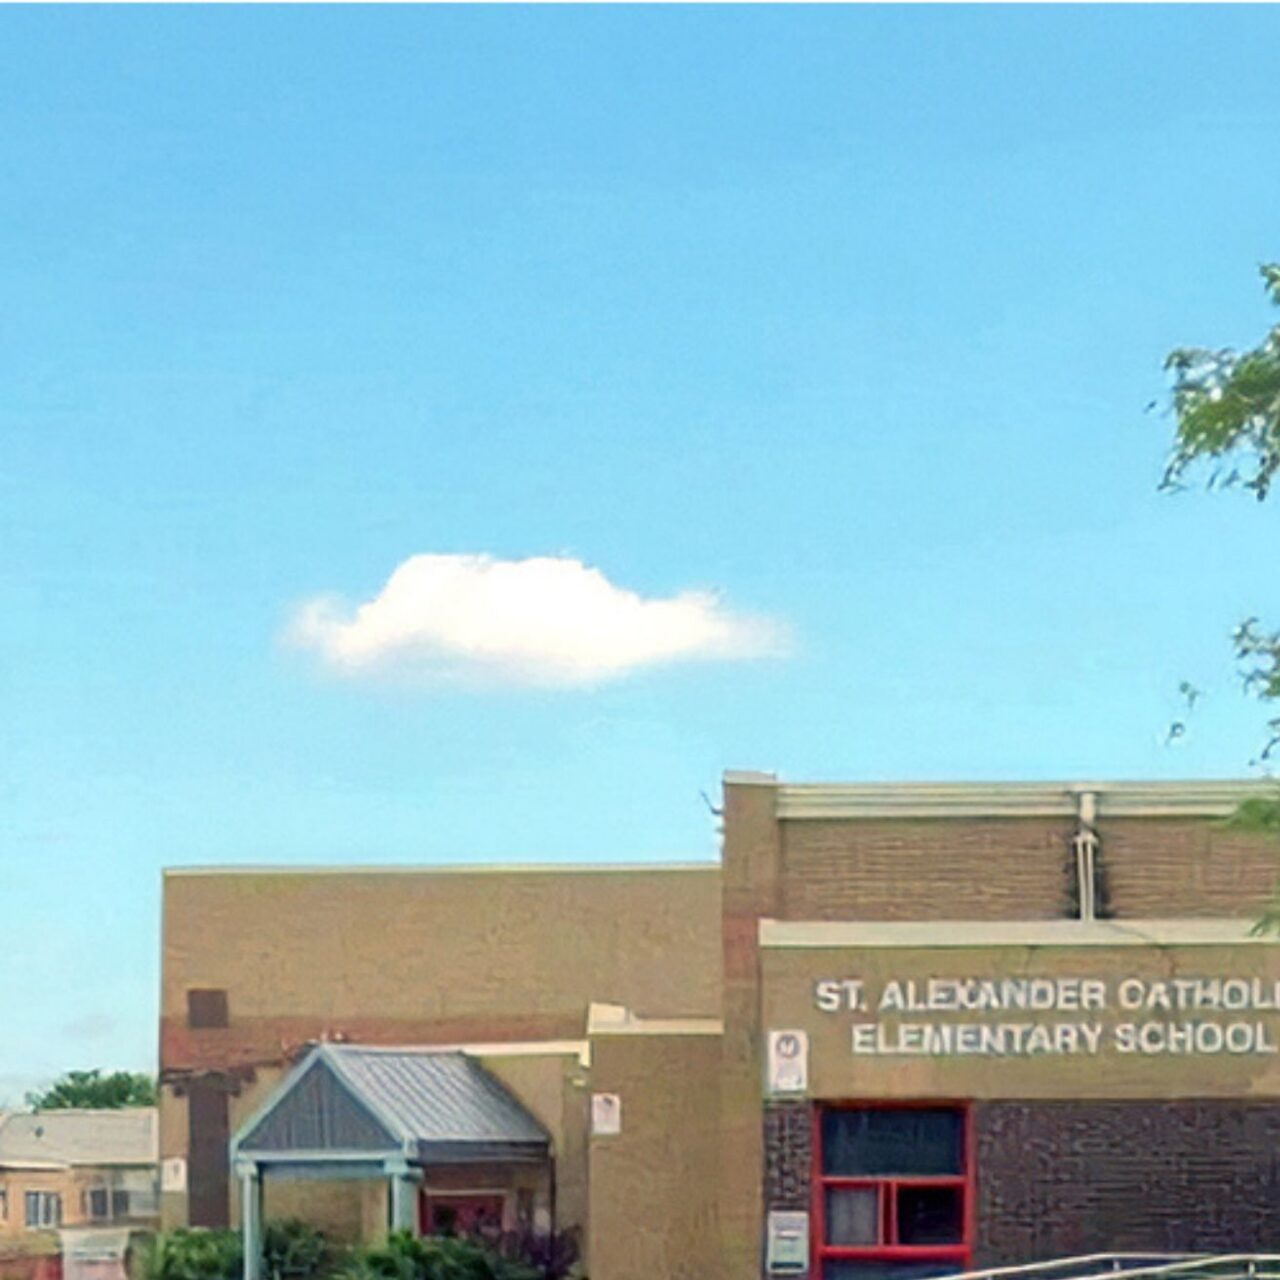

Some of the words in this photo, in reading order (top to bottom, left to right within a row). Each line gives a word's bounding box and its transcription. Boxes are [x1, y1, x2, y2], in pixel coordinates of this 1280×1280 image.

[815, 979, 868, 1012] ST.
[879, 979, 1107, 1011] ALEXANDER
[852, 1022, 1102, 1054] ELEMENTARY
[1114, 1022, 1279, 1053] SCHOOL
